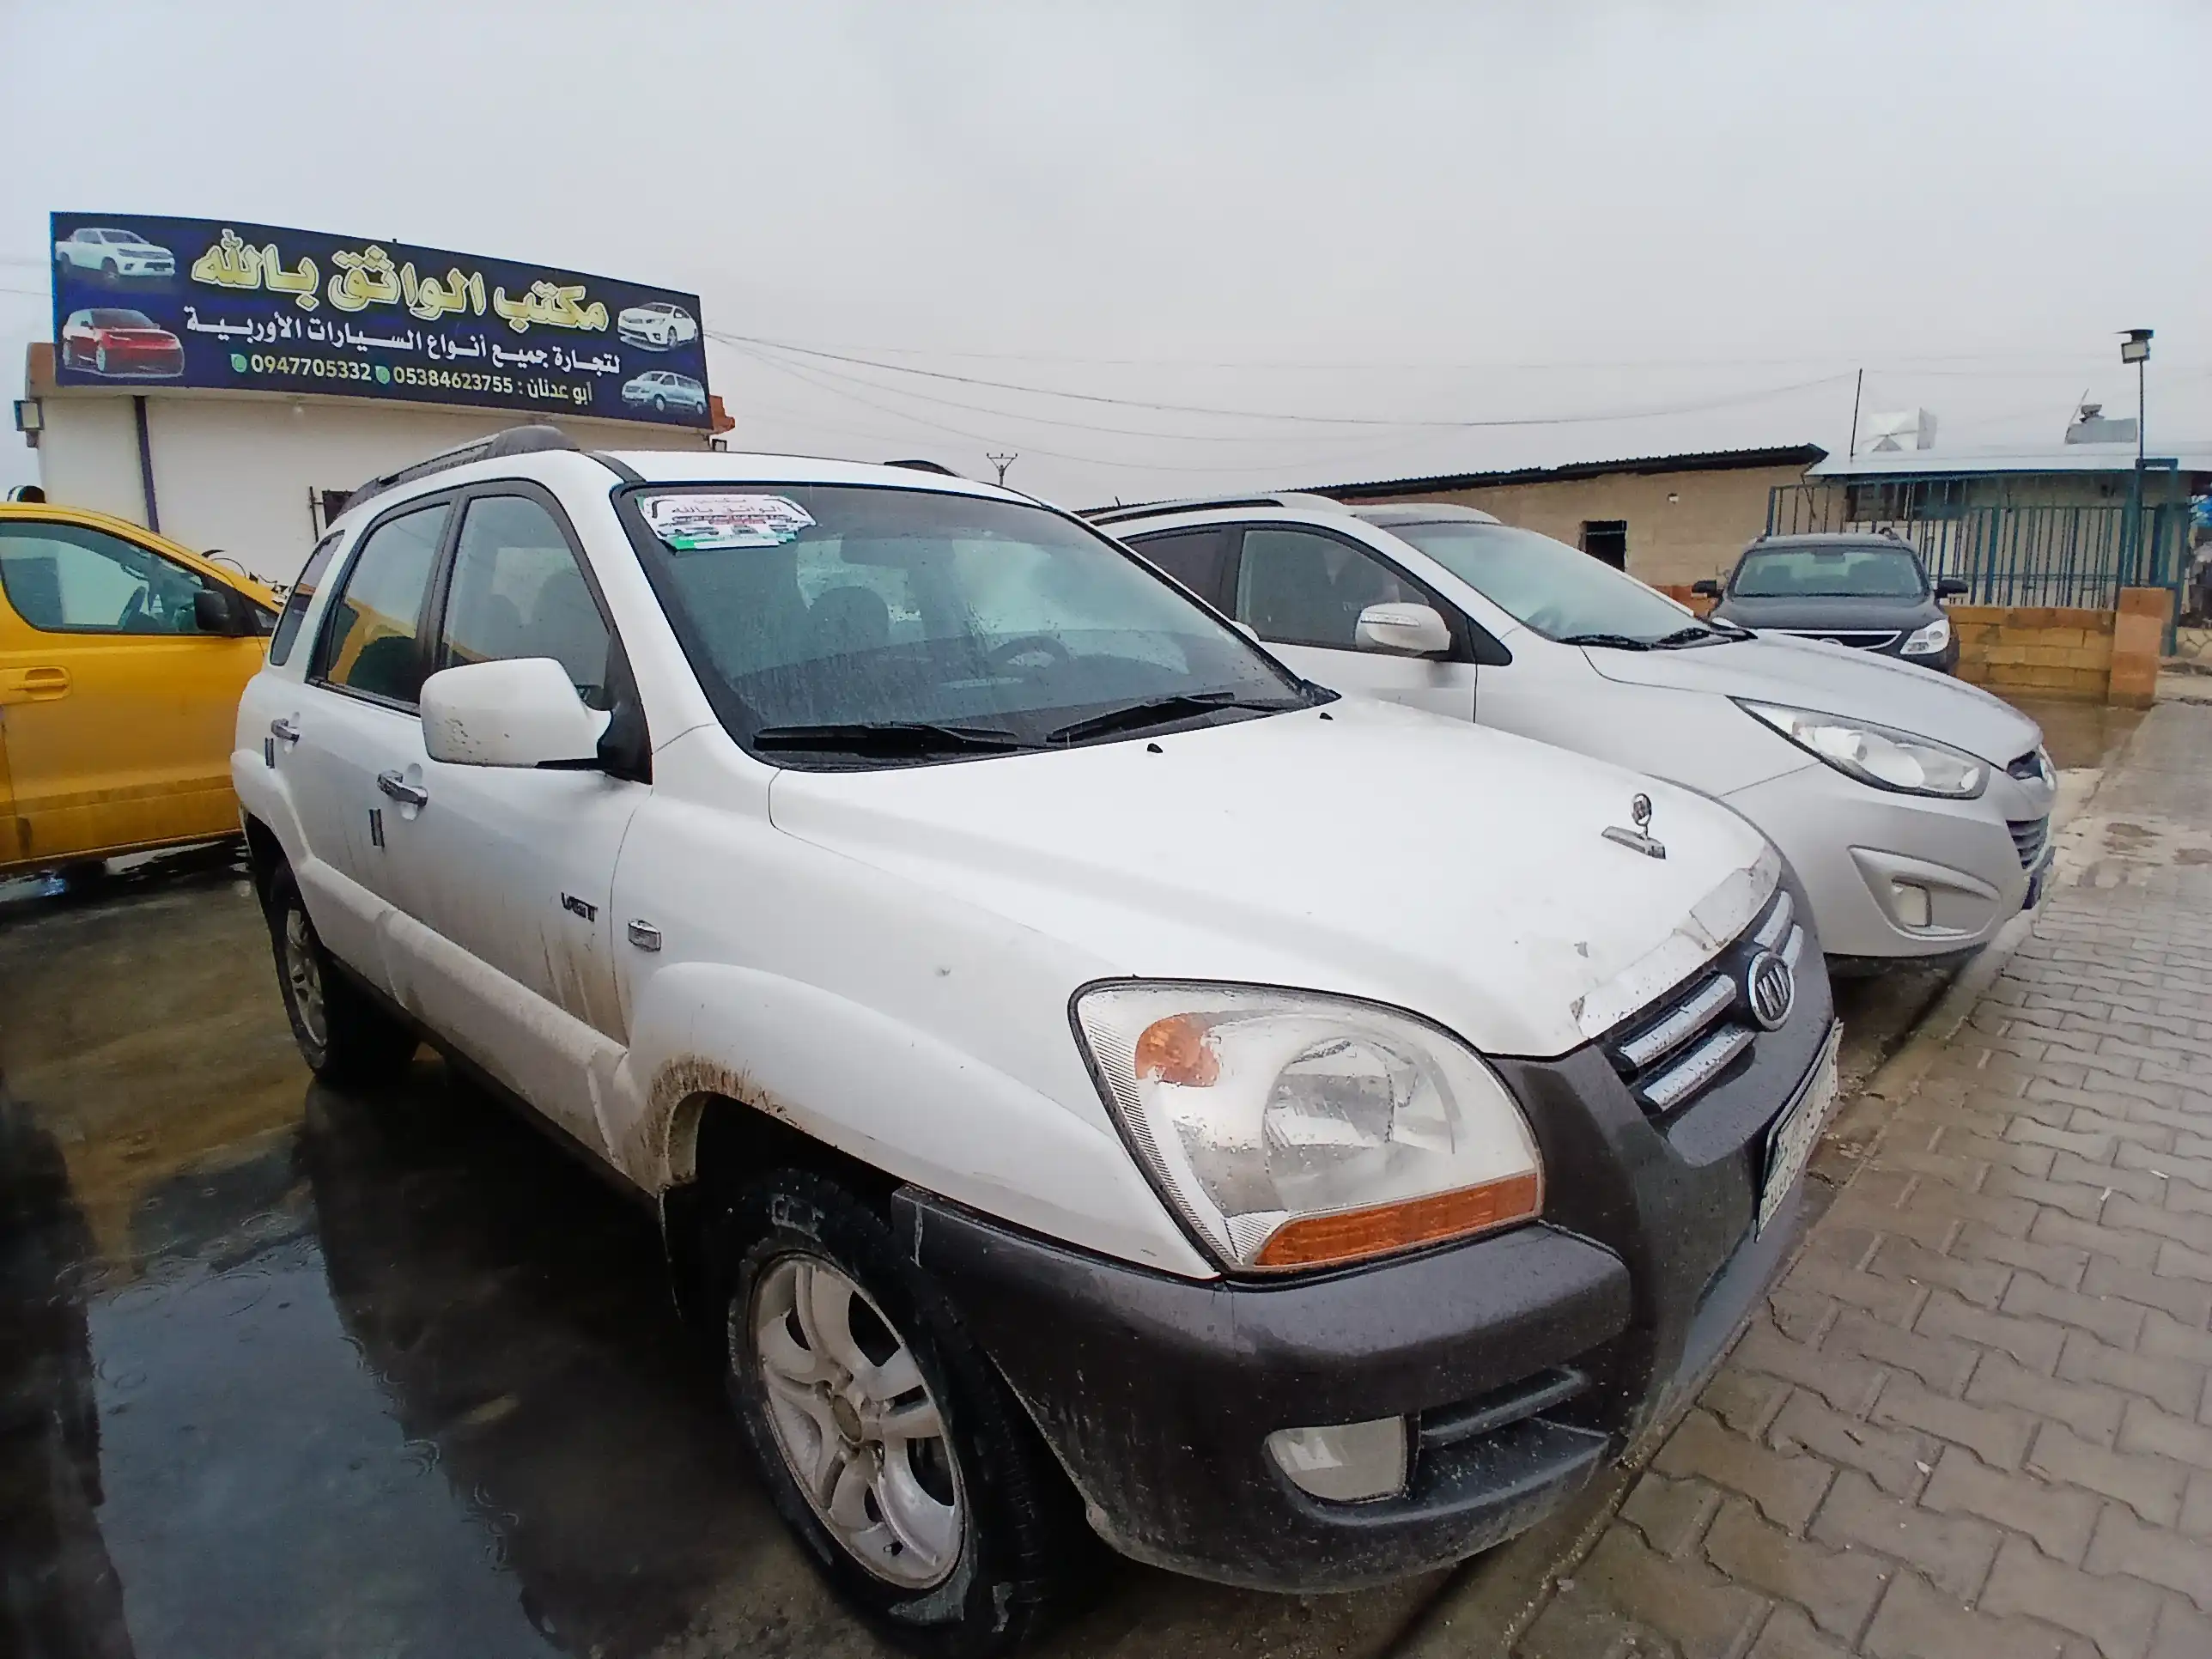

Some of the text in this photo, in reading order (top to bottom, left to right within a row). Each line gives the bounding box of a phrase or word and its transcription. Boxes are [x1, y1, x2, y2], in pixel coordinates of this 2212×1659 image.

[191, 228, 609, 333] مكتب الواثق بالله
[183, 306, 620, 377] لتجارة جميع أنواع السيارات الأوربية
[251, 354, 372, 380] 0947705332
[393, 366, 514, 394] 05384623755
[527, 378, 568, 398] عدنان
